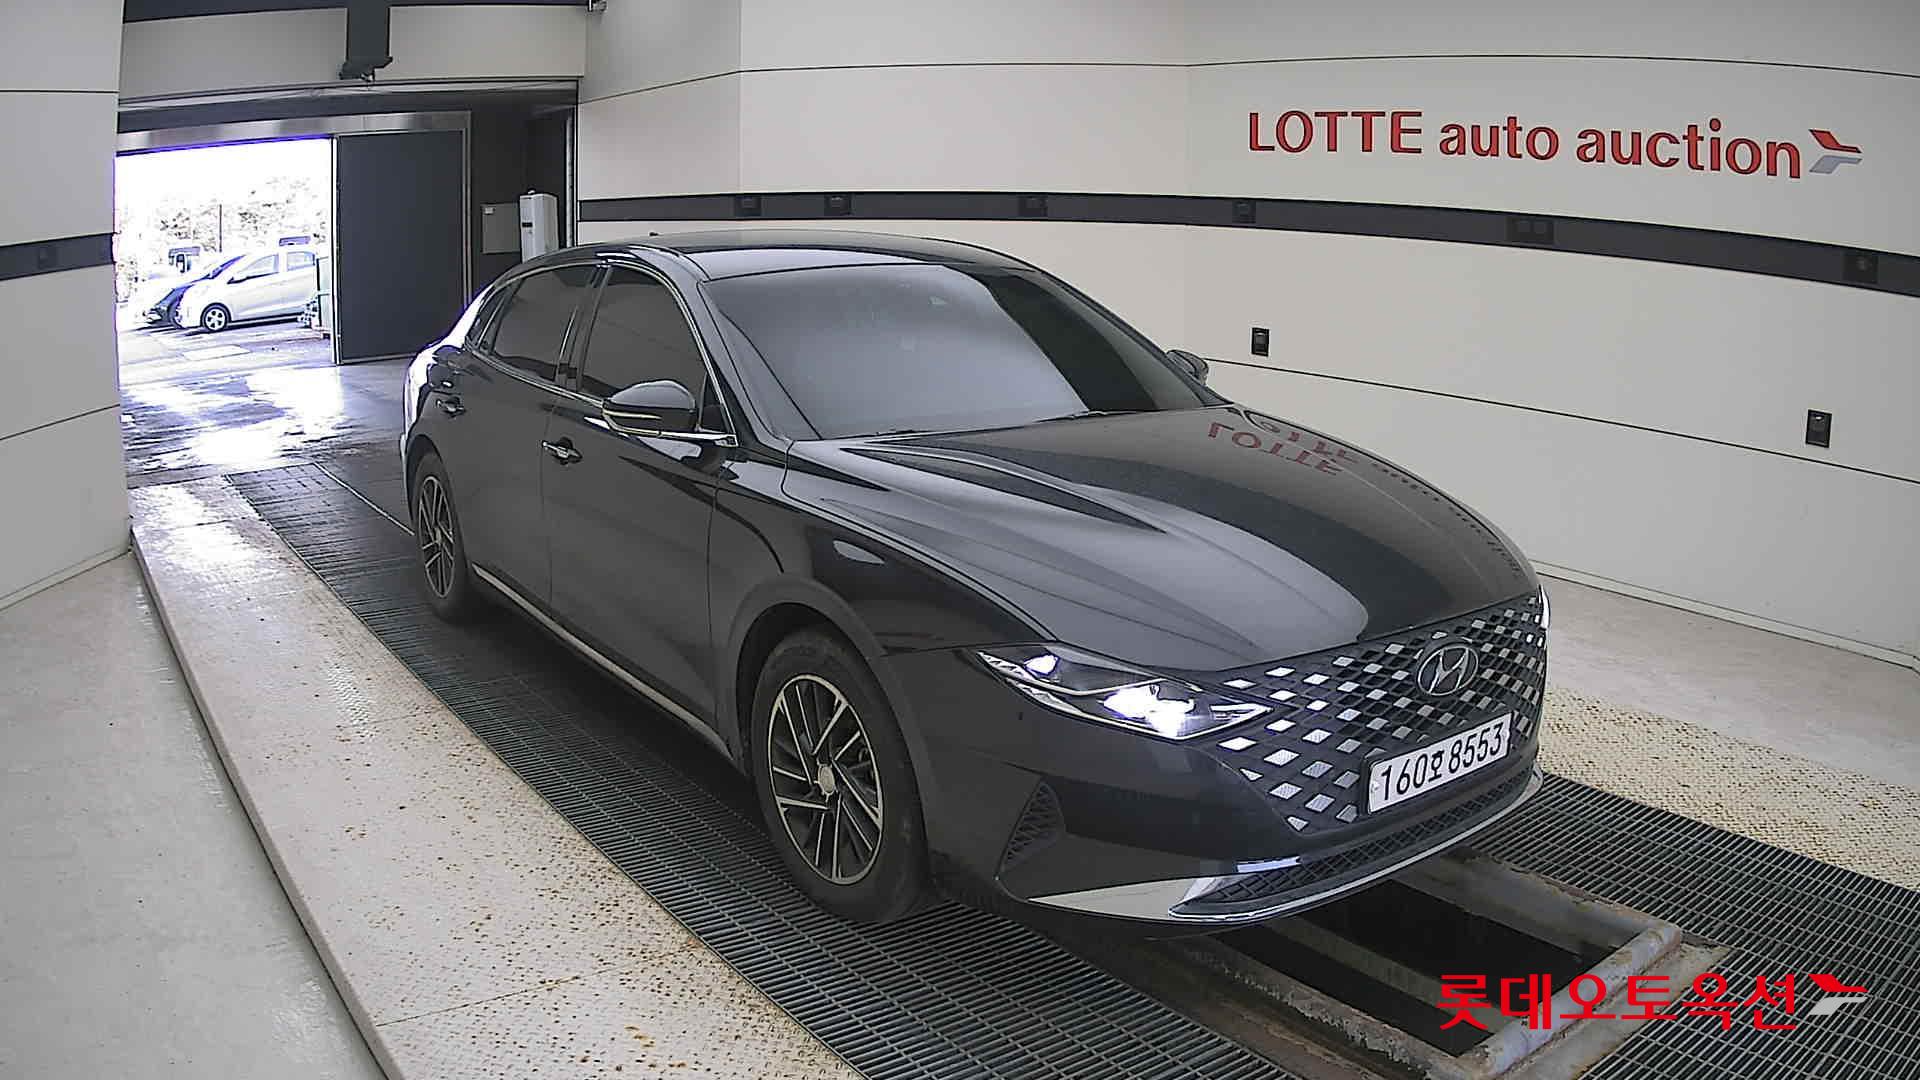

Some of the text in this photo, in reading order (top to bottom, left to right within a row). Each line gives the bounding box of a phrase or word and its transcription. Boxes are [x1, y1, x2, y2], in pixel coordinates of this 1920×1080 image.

[1248, 111, 1802, 179] LOTTE auto auction
